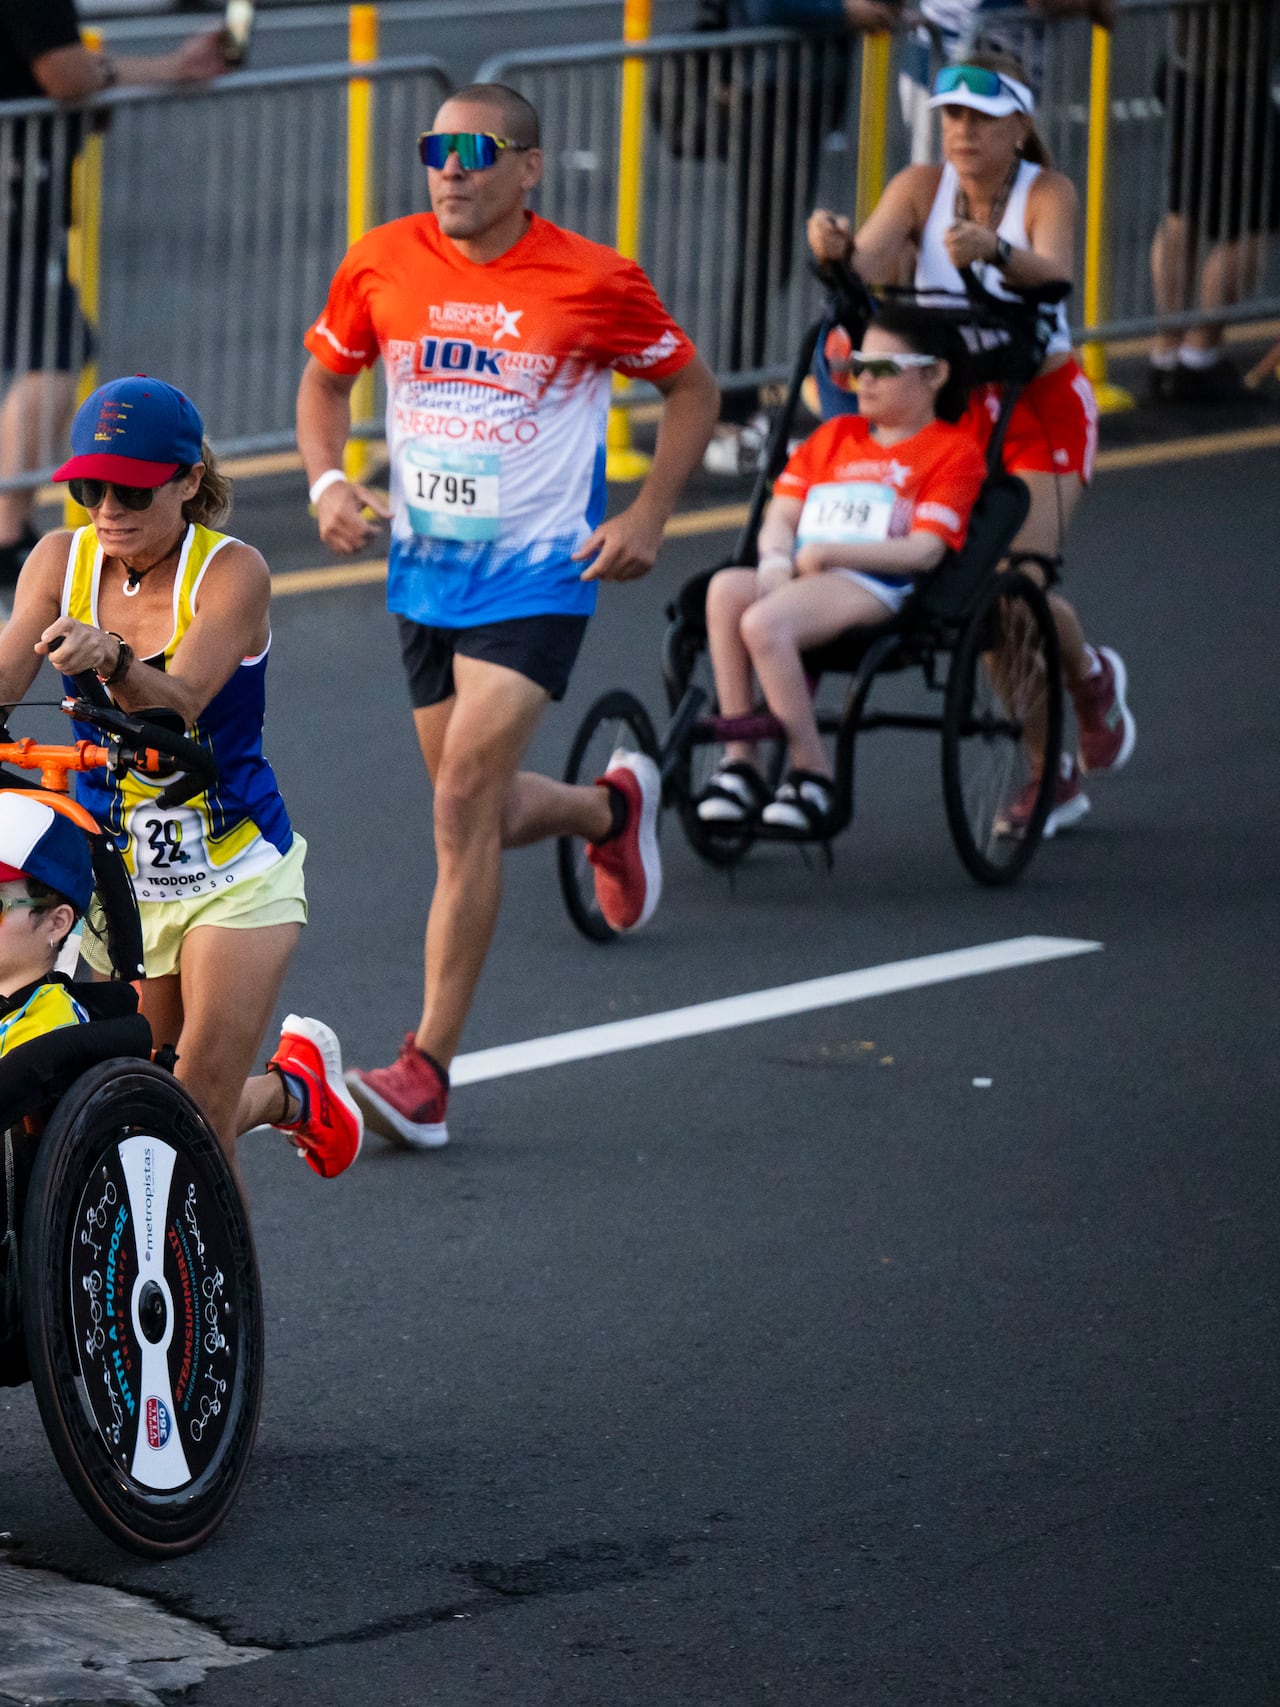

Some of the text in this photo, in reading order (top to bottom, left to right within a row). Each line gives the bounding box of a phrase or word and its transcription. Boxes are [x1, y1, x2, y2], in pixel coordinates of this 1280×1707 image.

[422, 337, 505, 375] 10K
[472, 420, 538, 444] RICO
[416, 471, 476, 505] 1795
[145, 819, 183, 844] 20
[149, 841, 191, 868] 24
[142, 874, 234, 897] OSCOSO
[147, 871, 206, 886] TEODORO
[142, 1148, 154, 1251] metropistas
[105, 1204, 136, 1417] WITH A PURPOSE
[118, 1249, 131, 1371] DRIVE SAFE
[168, 1225, 194, 1402] #TEAMSUMMERLIZ
[159, 1407, 167, 1438] 360
